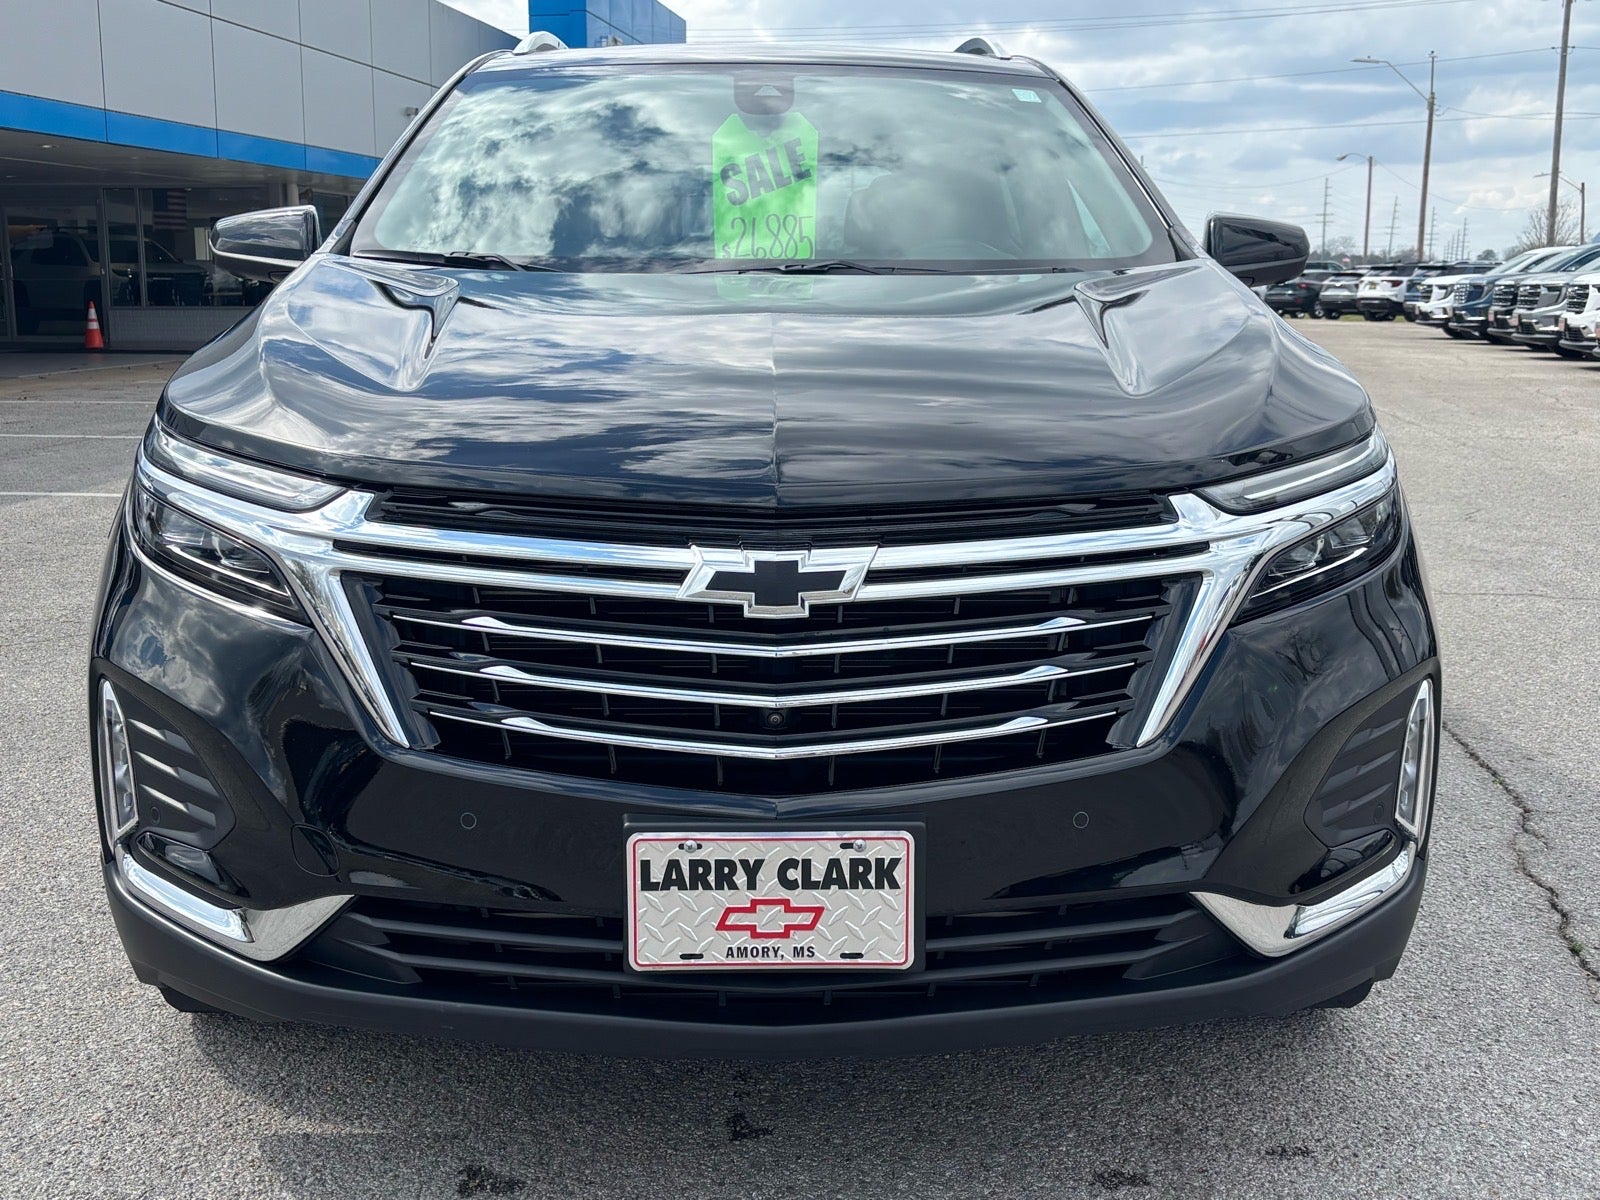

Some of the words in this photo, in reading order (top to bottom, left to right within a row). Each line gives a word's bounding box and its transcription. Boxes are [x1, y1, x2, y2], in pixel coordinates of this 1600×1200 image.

[720, 138, 812, 206] SALE
[640, 859, 765, 891] LARRY
[777, 857, 902, 890] CLARK
[725, 946, 785, 960] AMORY,
[793, 946, 815, 959] MS
